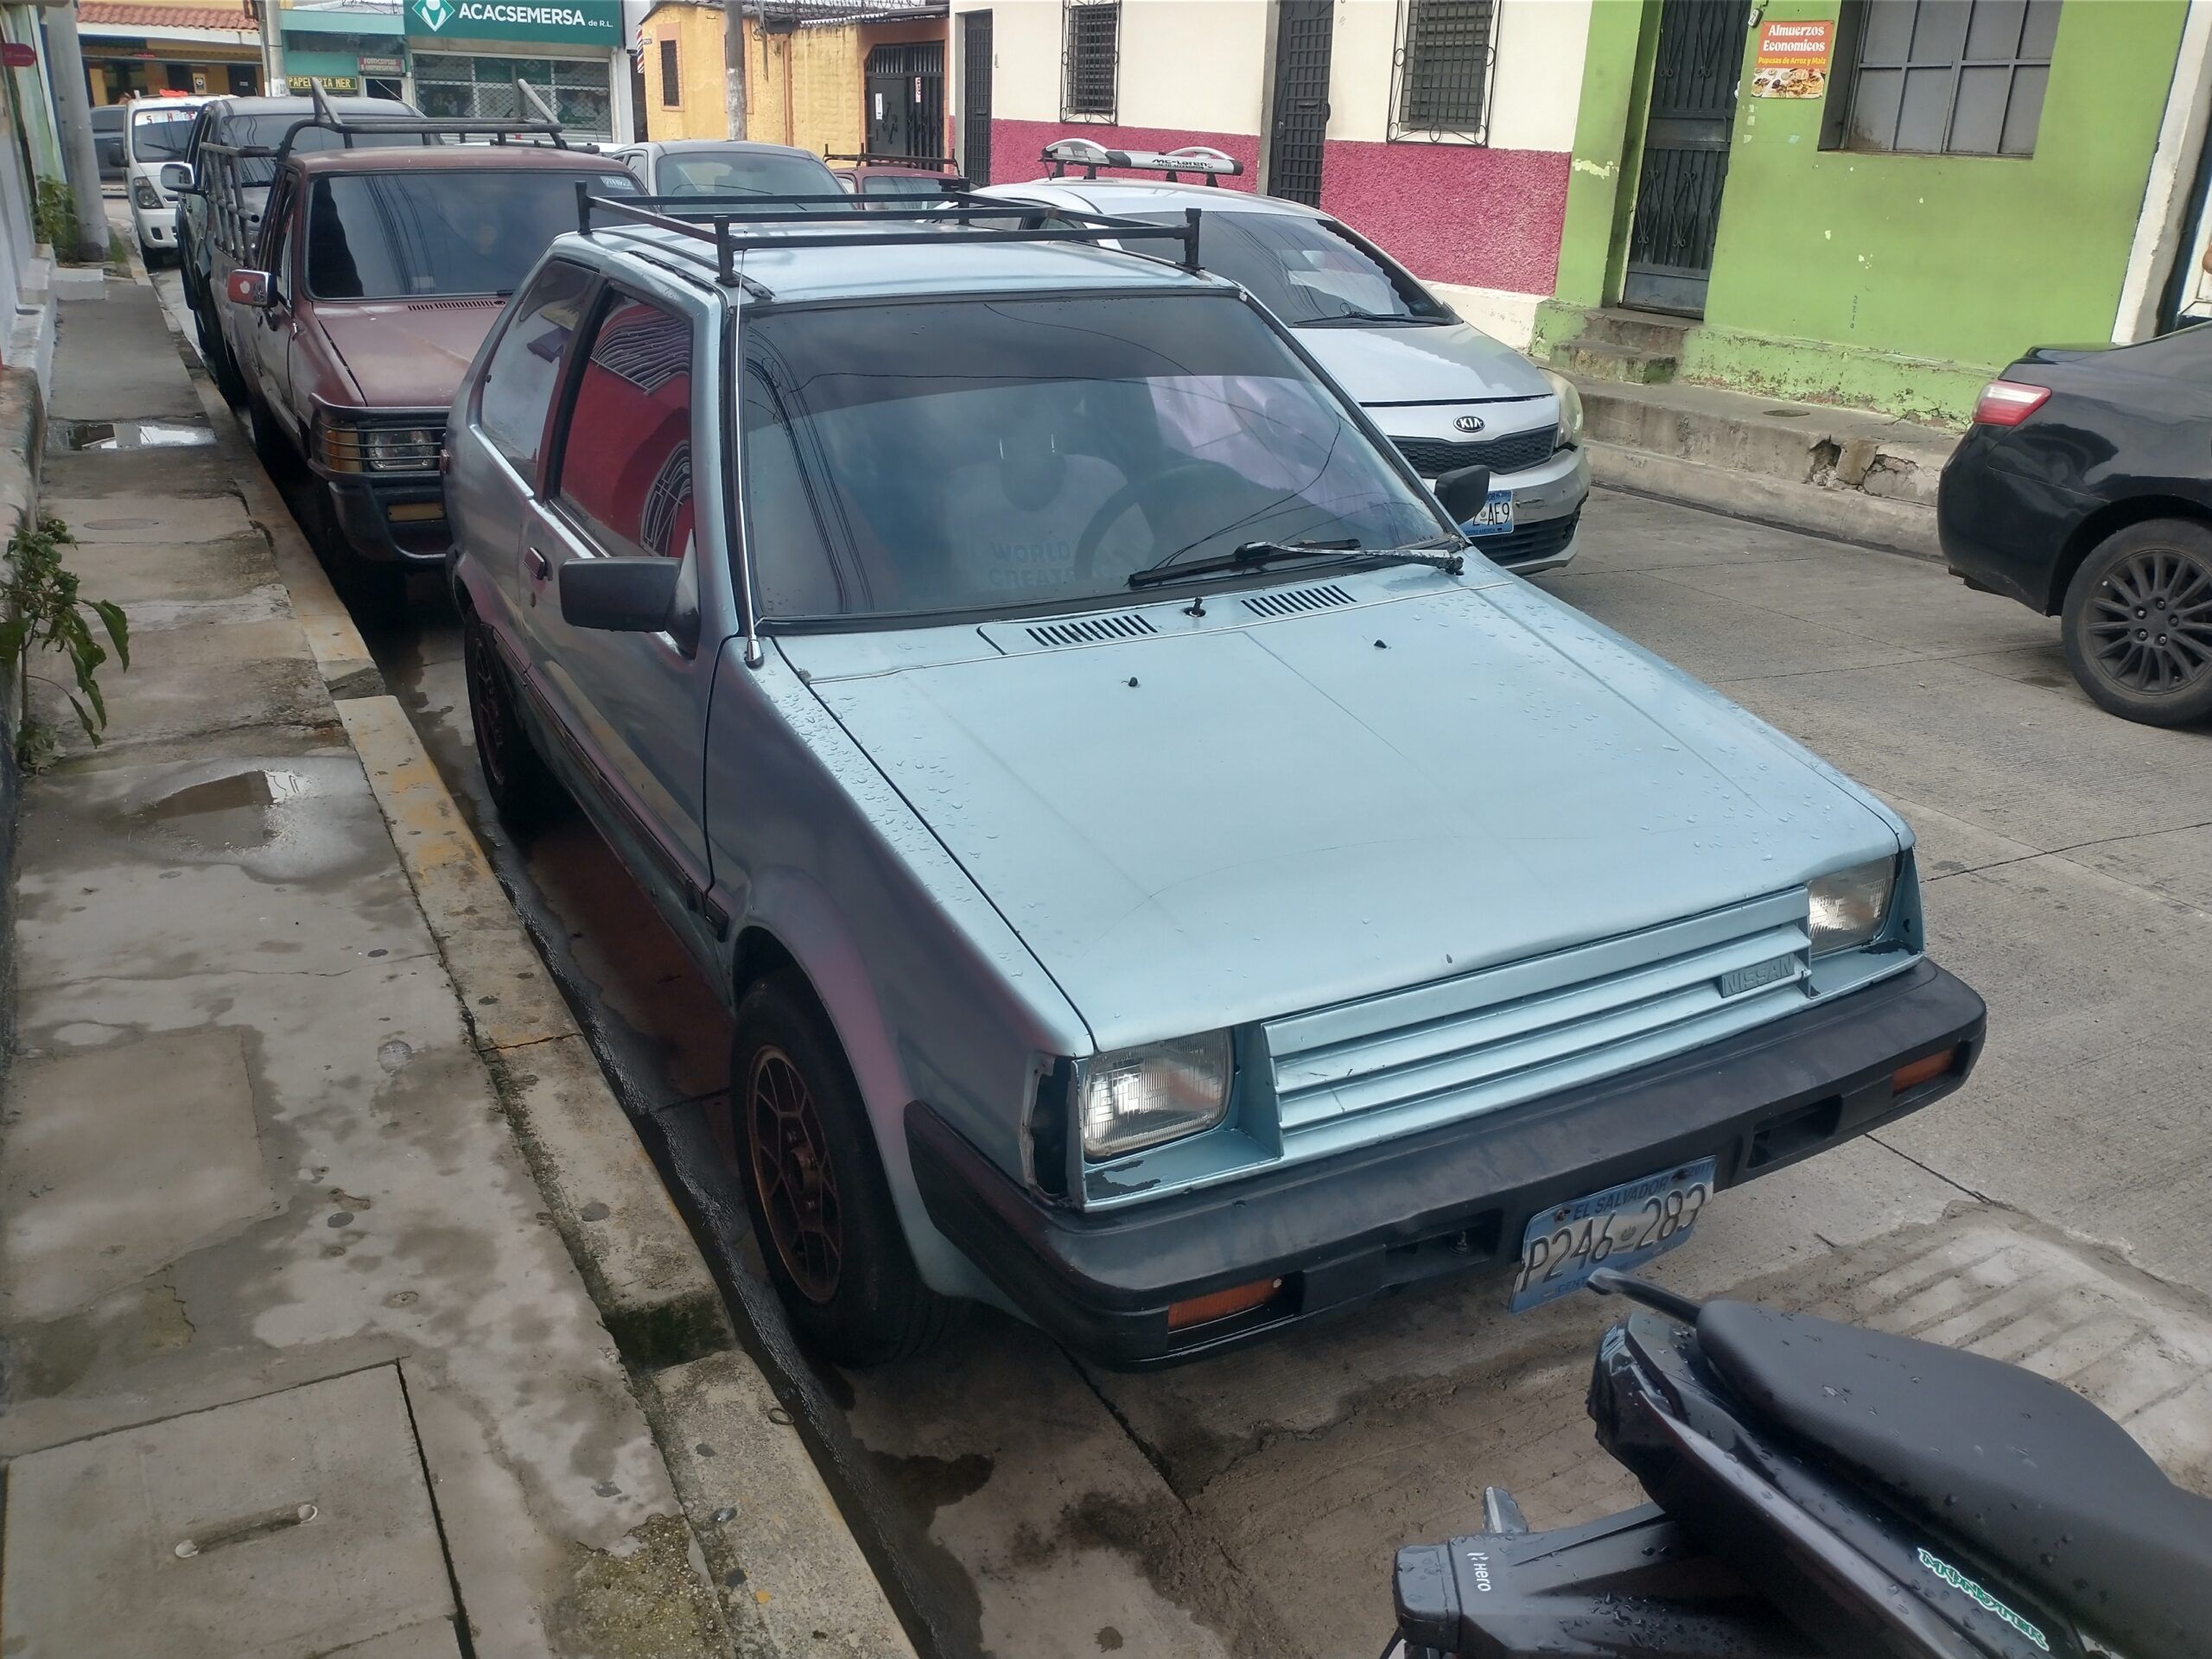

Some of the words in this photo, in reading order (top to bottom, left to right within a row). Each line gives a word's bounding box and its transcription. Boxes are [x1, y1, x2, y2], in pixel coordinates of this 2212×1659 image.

[459, 3, 586, 26] ACACSEMERSA
[1768, 24, 1824, 36] Almuerzos
[1763, 39, 1826, 52] Economicos
[288, 77, 334, 87] PAPELRIA
[335, 78, 351, 88] MER
[1459, 417, 1481, 429] KIA
[1722, 953, 1796, 997] NISSAN
[1573, 1205, 1590, 1221] EL
[1594, 1176, 1669, 1213] SALVADOR
[1520, 1210, 1618, 1293] P246
[1633, 1182, 1706, 1251] 283
[1473, 1563, 1491, 1592] Hero
[1916, 1548, 2050, 1651] MONSTER
